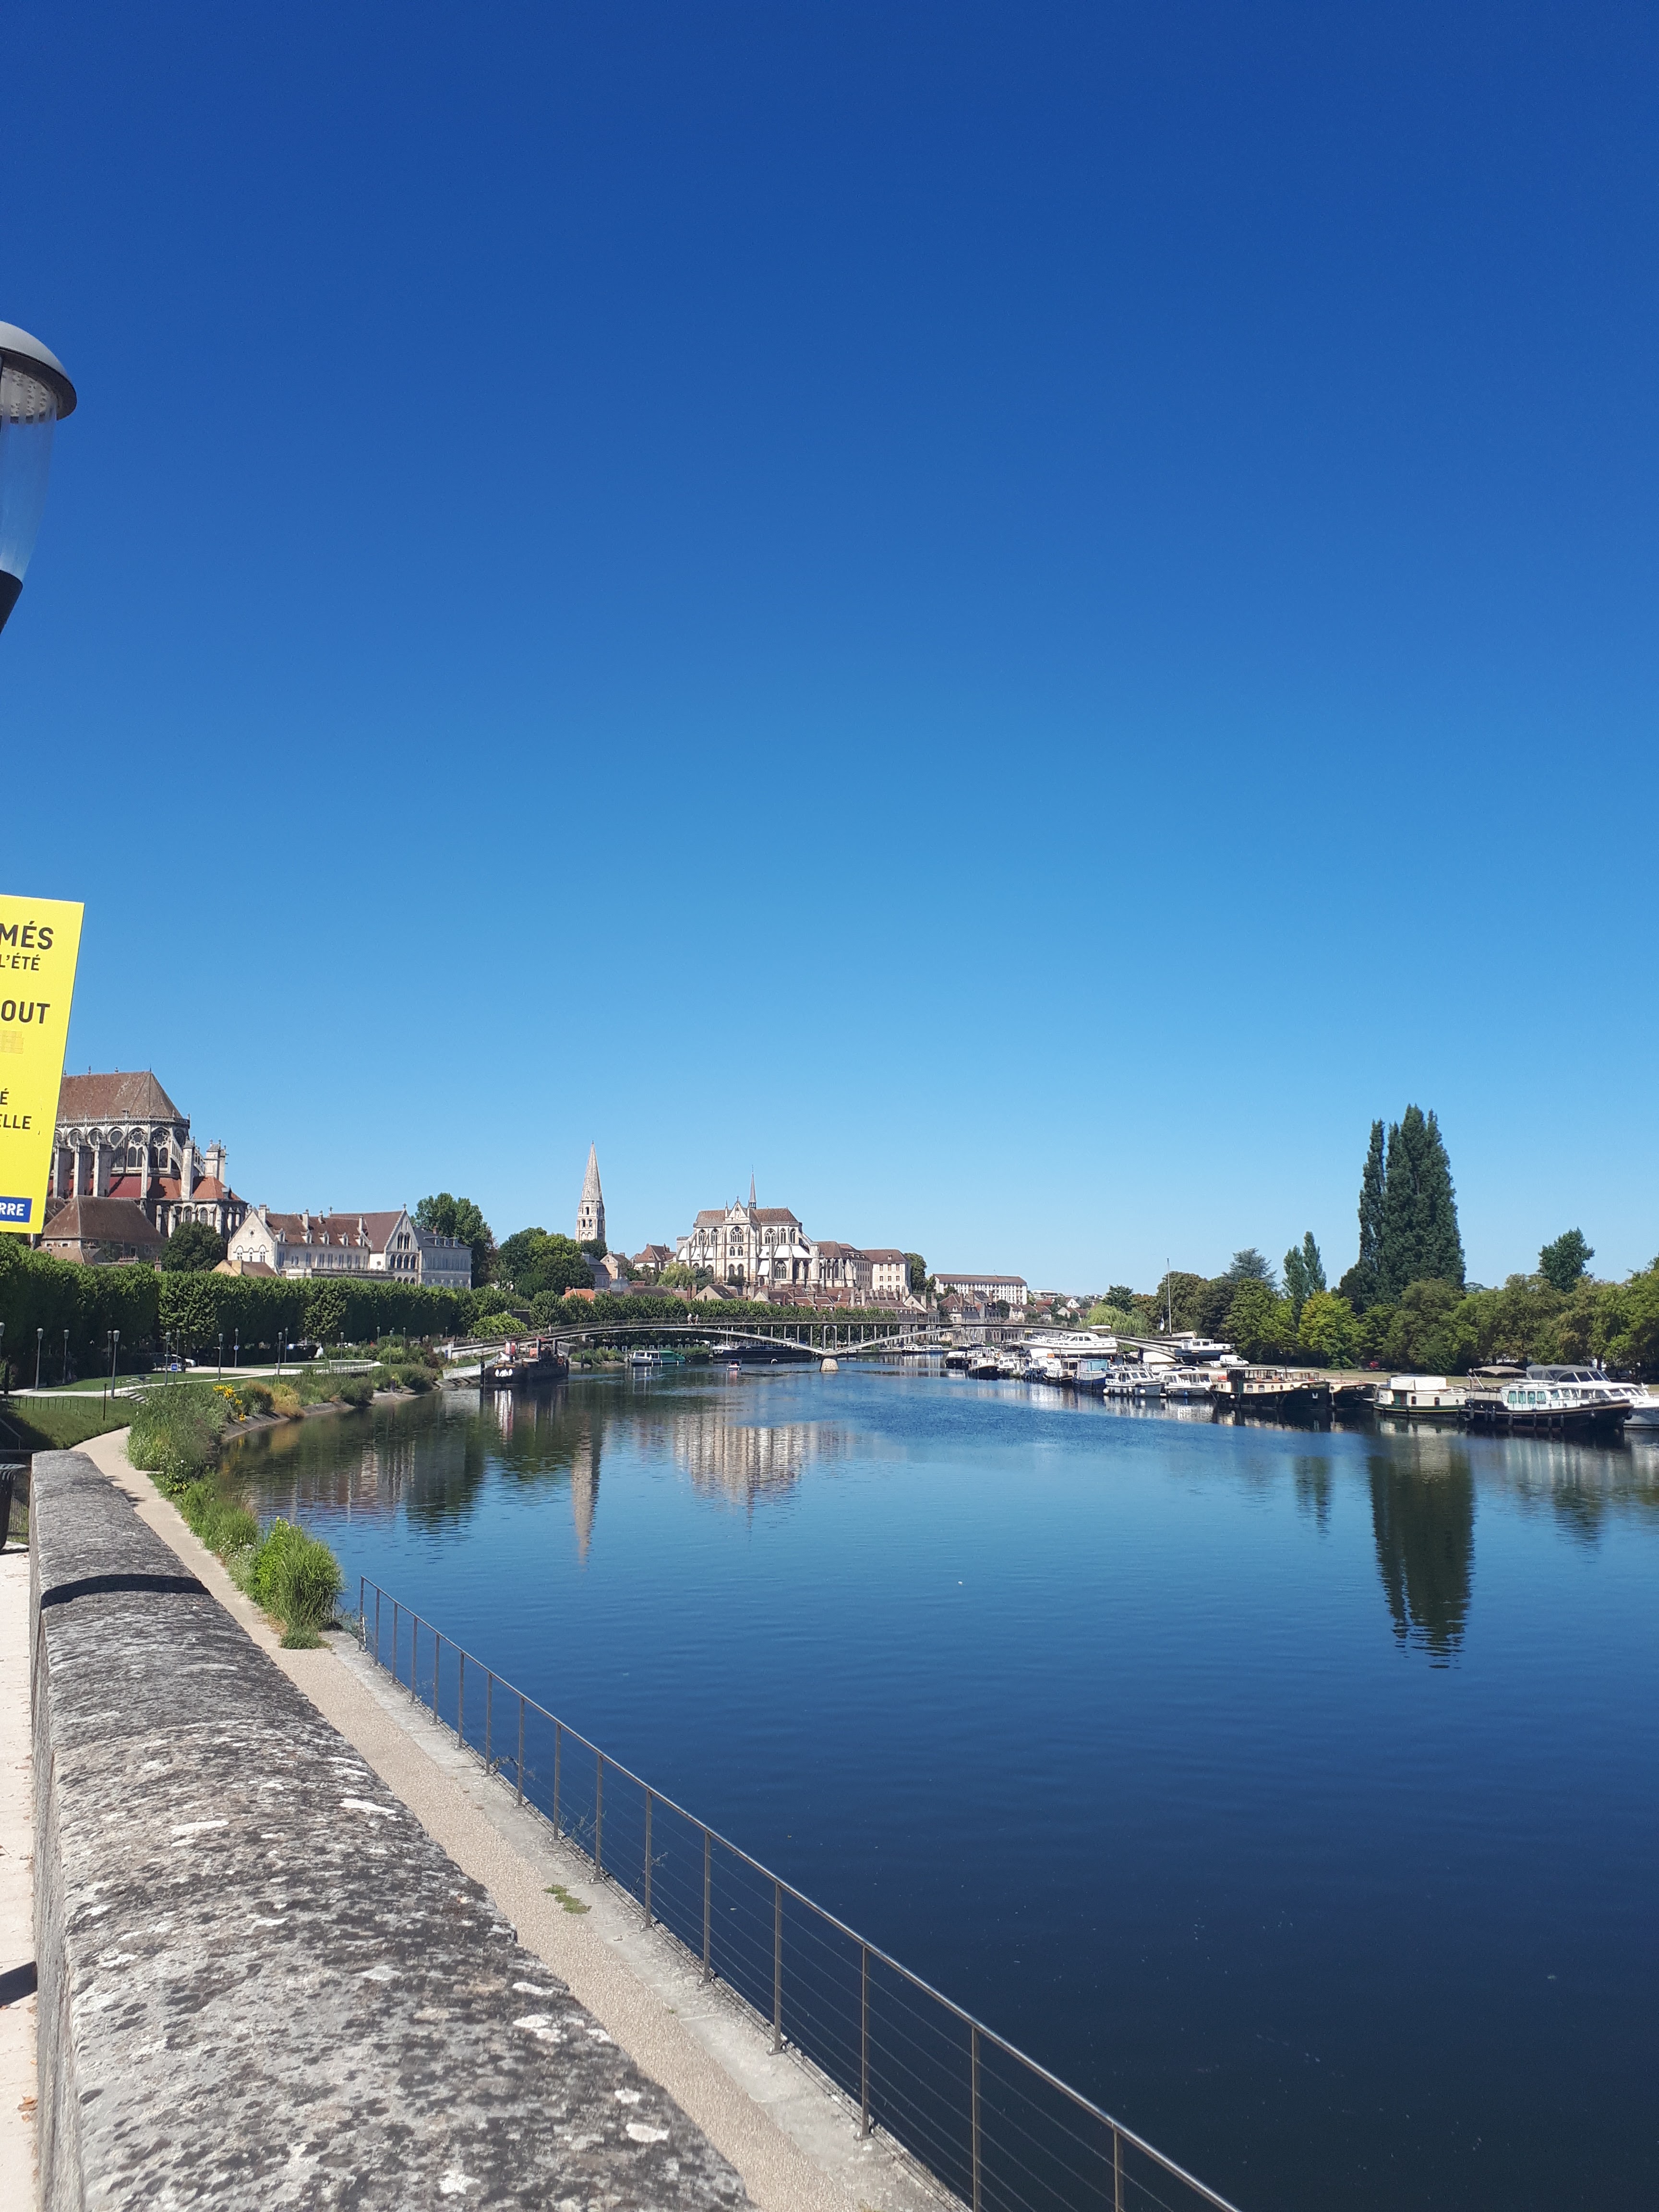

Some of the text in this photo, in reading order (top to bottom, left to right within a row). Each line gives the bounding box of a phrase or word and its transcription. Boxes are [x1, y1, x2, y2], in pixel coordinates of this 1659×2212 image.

[0, 921, 53, 950] MÉS
[1, 1000, 50, 1024] OUT
[0, 1202, 25, 1216] RRE
